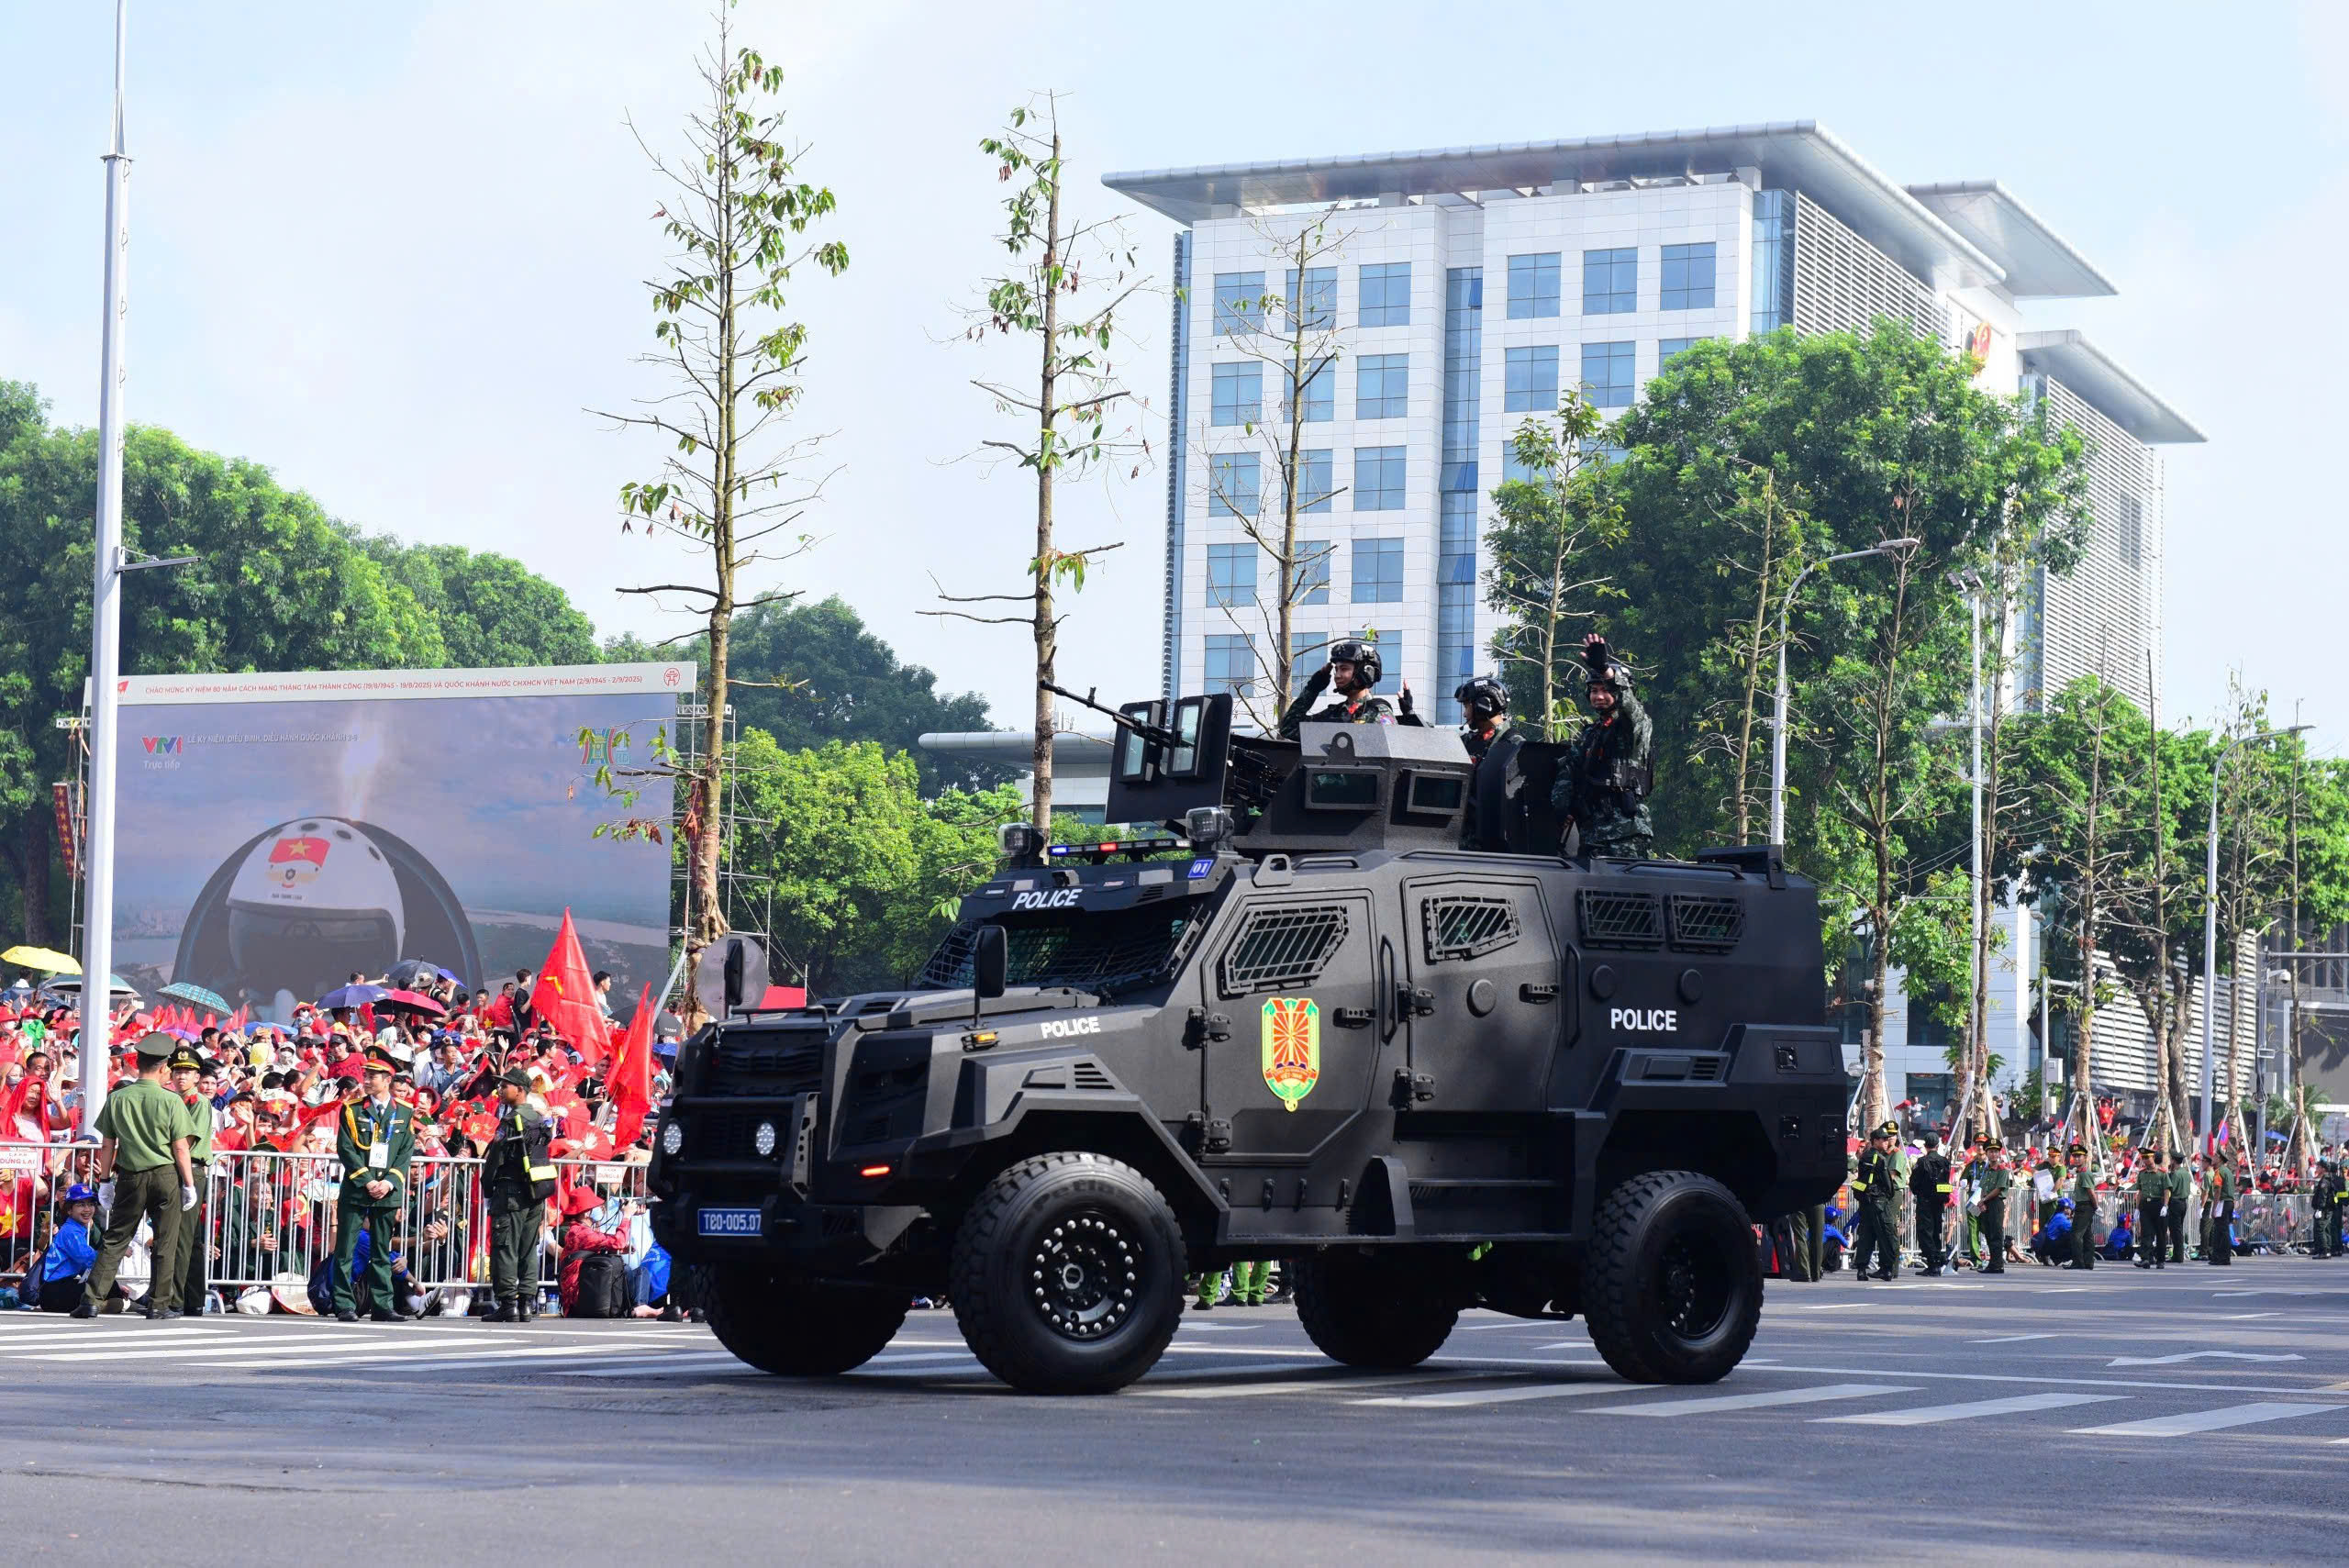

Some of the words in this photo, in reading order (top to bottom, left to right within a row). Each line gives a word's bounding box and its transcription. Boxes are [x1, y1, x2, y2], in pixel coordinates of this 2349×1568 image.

[239, 684, 257, 692] CÁCH
[279, 683, 302, 692] THÁNG
[303, 683, 317, 691] TÁM
[342, 682, 362, 690] CÔNG
[362, 682, 395, 690] (19/8/1945
[399, 681, 431, 690] 19/8/2025)
[432, 680, 443, 688] VÀ
[444, 679, 464, 689] QUỐC
[465, 679, 490, 688] KHÁNH
[513, 679, 541, 687] CHXHCN
[542, 677, 558, 686] VIỆT
[576, 676, 607, 685] (2/9/1945
[612, 675, 643, 684] 2/9/2025)
[141, 737, 183, 755] VTV1
[143, 760, 162, 770] Trực
[164, 758, 181, 771] tiếp
[1193, 862, 1208, 873] 01
[1012, 888, 1083, 910] POLICE
[1041, 1016, 1101, 1039] POLICE
[1610, 1007, 1677, 1031] POLICE
